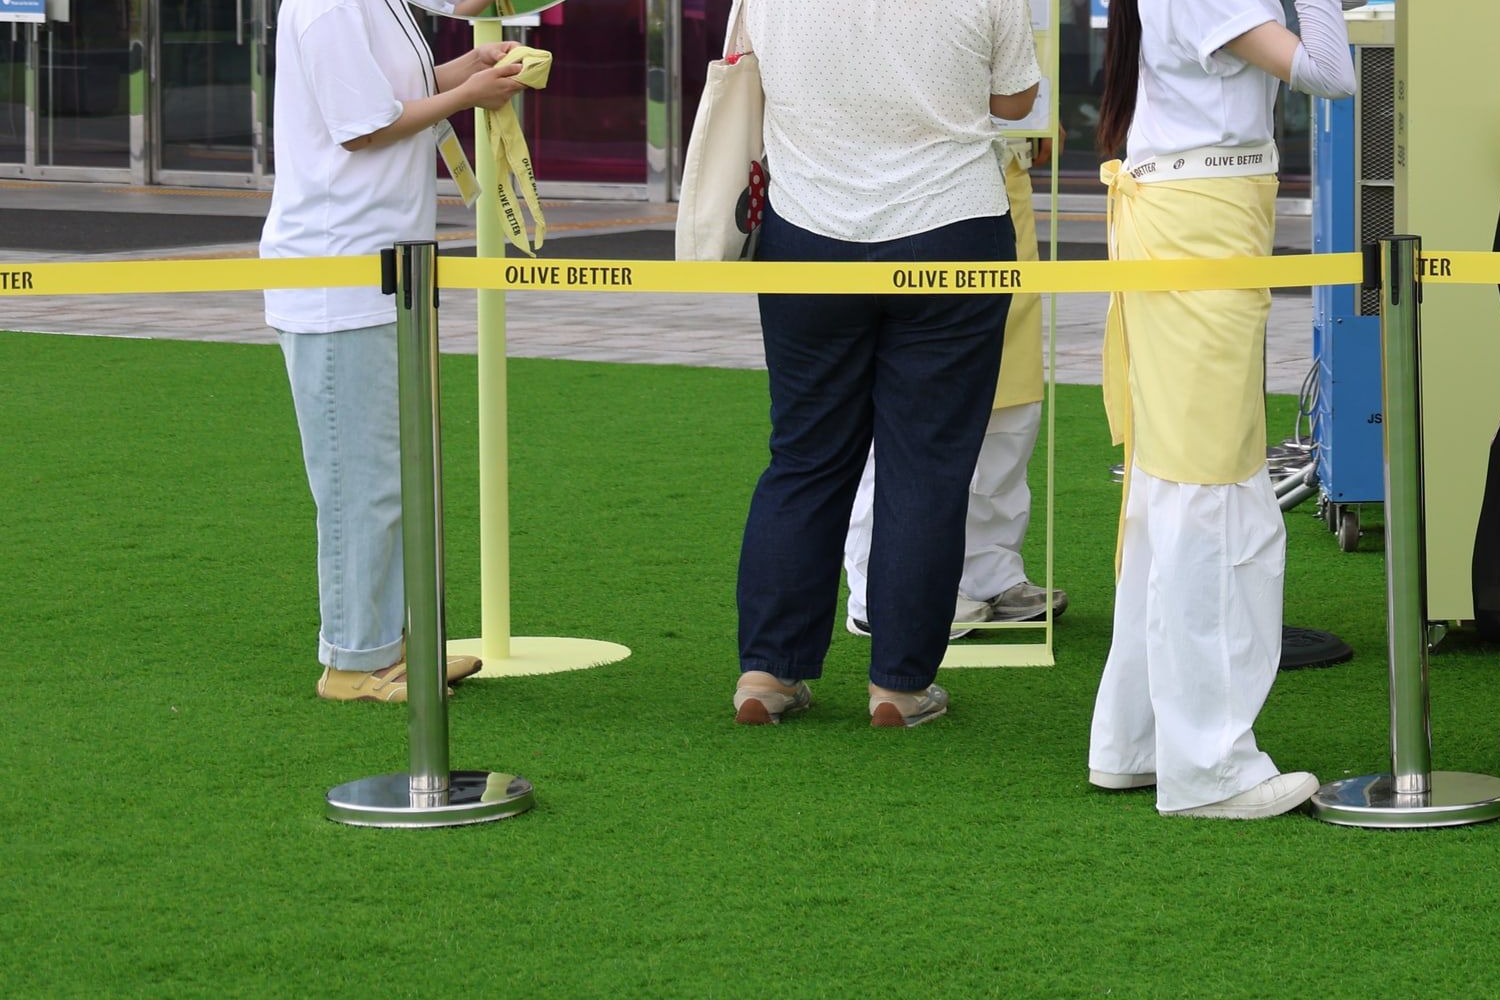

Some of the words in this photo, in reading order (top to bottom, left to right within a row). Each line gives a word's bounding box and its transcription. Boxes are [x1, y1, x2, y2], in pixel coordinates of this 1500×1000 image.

[1205, 156, 1234, 167] OLIVE
[1237, 154, 1264, 166] BETTER
[497, 183, 511, 207] OLIVE
[504, 207, 521, 236] BETTER
[0, 272, 33, 290] TER
[505, 265, 561, 286] OLIVE
[567, 266, 633, 286] BETTER
[892, 269, 949, 289] OLIVE
[956, 269, 1022, 289] BETTER
